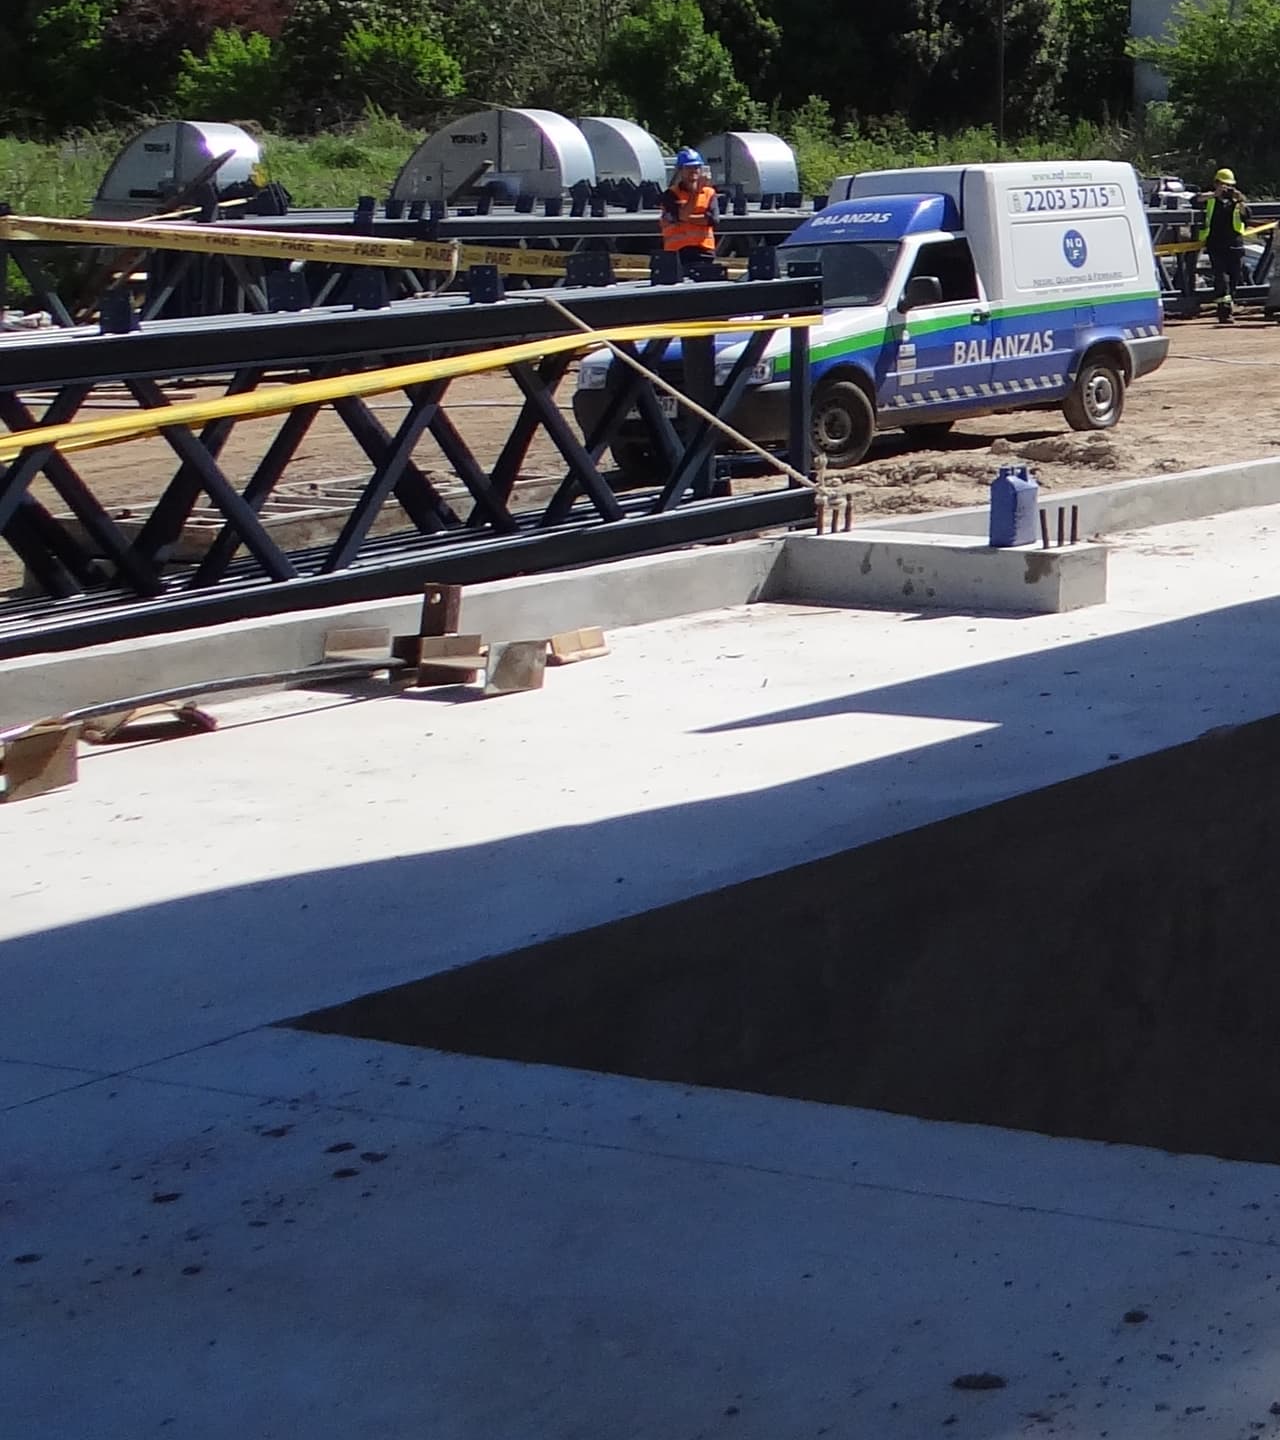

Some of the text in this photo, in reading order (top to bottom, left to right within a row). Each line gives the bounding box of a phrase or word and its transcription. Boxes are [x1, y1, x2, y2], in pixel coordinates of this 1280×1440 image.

[1024, 189, 1066, 212] 2203
[1071, 186, 1109, 209] 5715
[811, 212, 892, 227] BALANZAS
[354, 243, 387, 257] PARE
[485, 251, 513, 266] PARE
[953, 329, 1054, 365] BALANZAS
